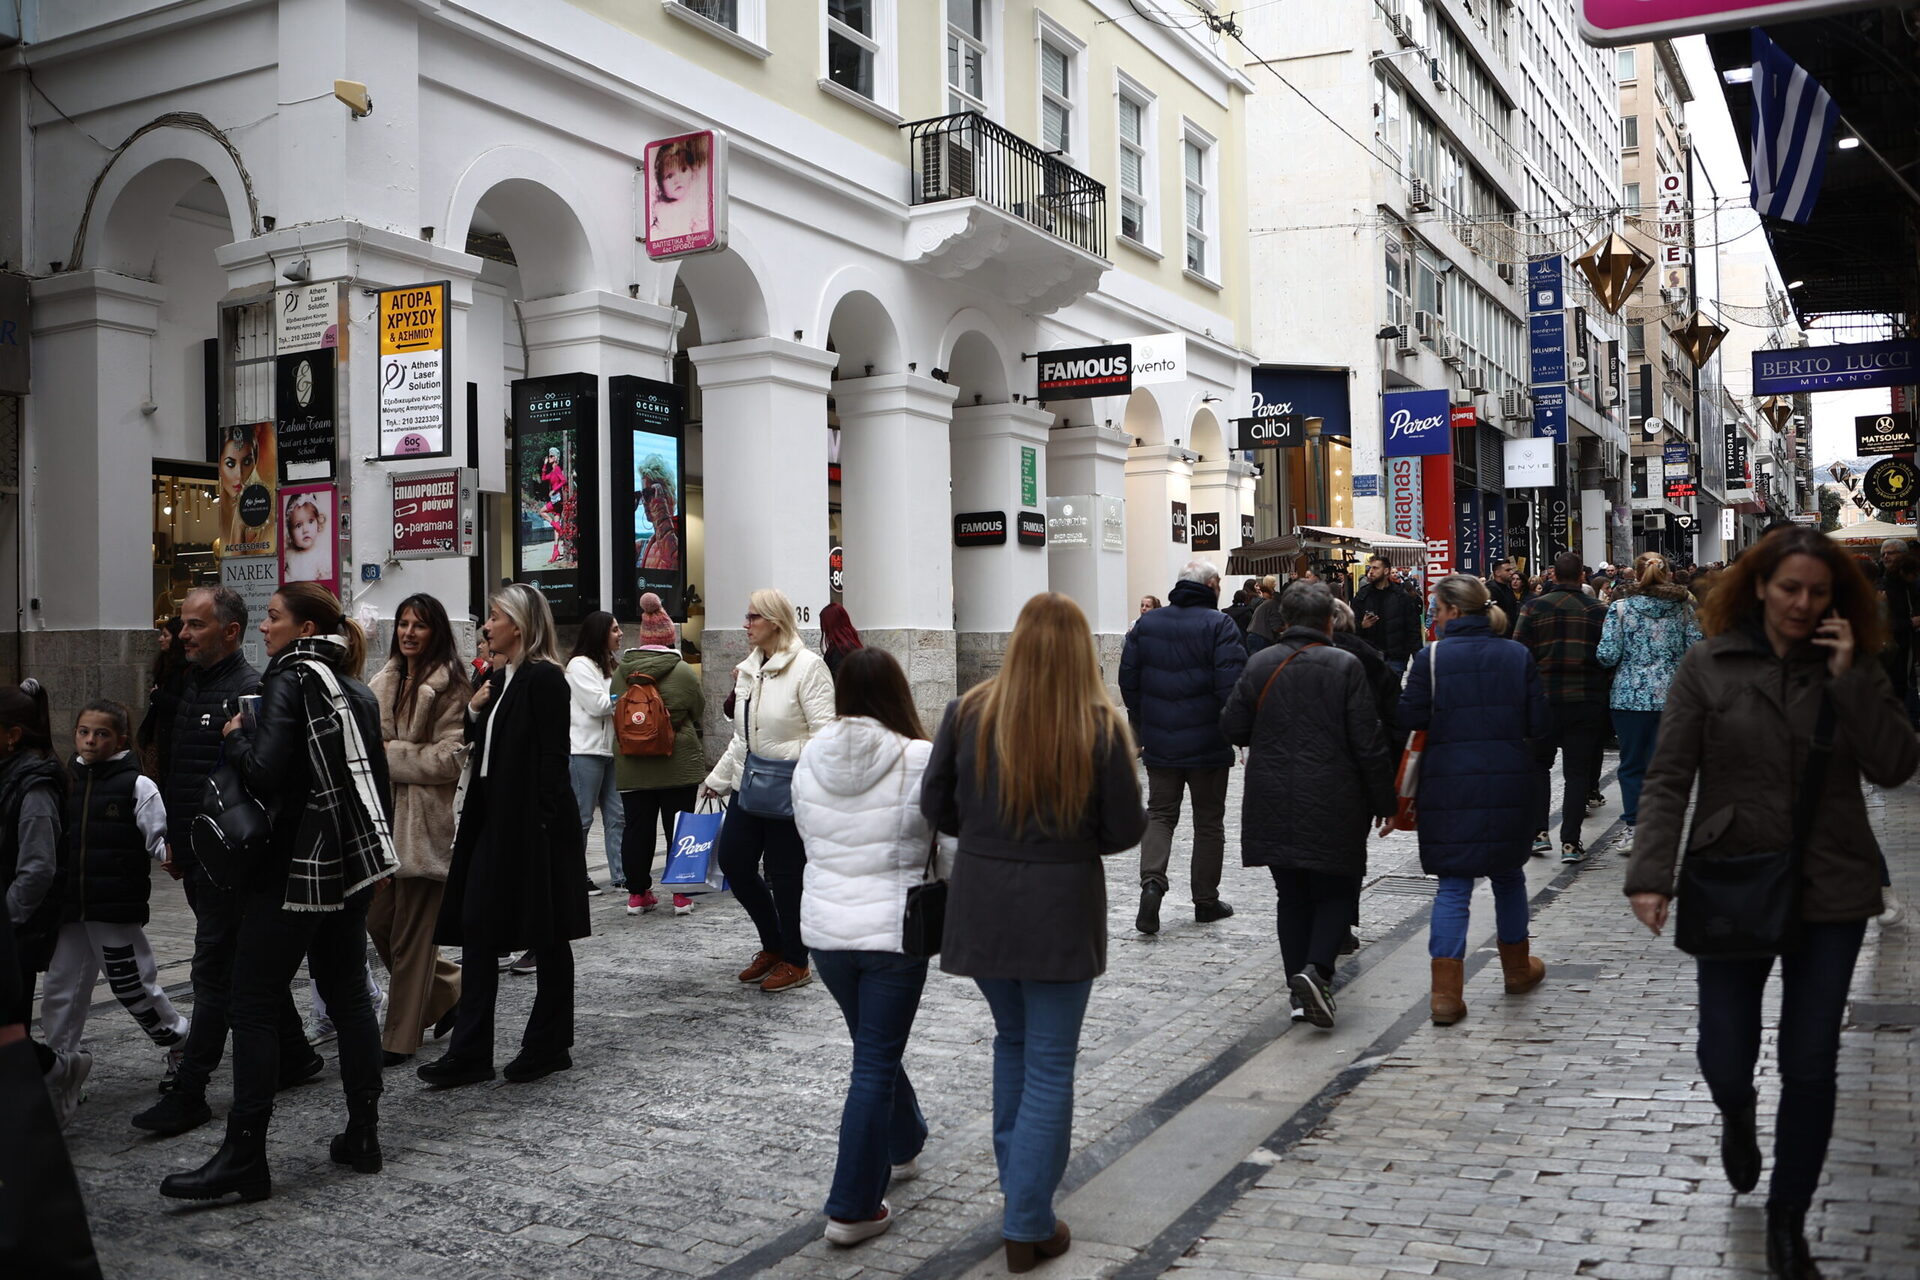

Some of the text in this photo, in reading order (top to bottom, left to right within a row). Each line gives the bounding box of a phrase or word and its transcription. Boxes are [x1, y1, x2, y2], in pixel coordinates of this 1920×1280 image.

[652, 238, 684, 249] ΒΑΠΤΙΣΤΙΚΑ
[672, 242, 695, 251] ΟΡΟΦΟΣ
[392, 291, 432, 310] ΑΓΟΡΑ
[387, 309, 436, 329] ΧΡΥΣΟΥ
[390, 328, 434, 342] & ΑΣΗΜΙΟΥ
[411, 361, 438, 369] Athens
[1043, 356, 1127, 381] FAMOUS
[1132, 358, 1176, 374] vvento
[1762, 351, 1912, 376] BERTO LUCCI
[414, 371, 435, 379] Laser
[1801, 374, 1872, 385] MILANO
[409, 381, 440, 390] Solution
[530, 400, 571, 411] OCCHIO
[636, 401, 669, 414] OCCHIO
[1252, 392, 1293, 417] Parex
[306, 416, 331, 430] Team
[415, 415, 439, 424] 3223309
[1389, 409, 1444, 440] Parex
[1251, 417, 1290, 439] alibi
[309, 436, 326, 445] Make
[404, 437, 420, 446] 6ος
[1861, 433, 1910, 443] MATSOUKA
[298, 447, 316, 455] School
[395, 482, 454, 500] ΕΠΙΔΙΟΡΘΩΣΕΙΣ
[422, 498, 454, 512] ρούχων
[1394, 460, 1413, 538] aianas
[394, 520, 452, 539] e-paramana
[961, 521, 1002, 532] FAMOUS
[1023, 521, 1044, 533] FAMOUS
[1191, 519, 1218, 536] alibi
[1242, 522, 1254, 538] alib
[1508, 526, 1525, 535] et's
[1551, 501, 1566, 561] estino
[1462, 502, 1472, 569] ENVIE
[225, 542, 270, 552] ACCESSORIES
[226, 564, 274, 581] NAREK
[1426, 540, 1448, 592] MPER
[796, 606, 810, 623] 36
[674, 835, 713, 858] Parex
